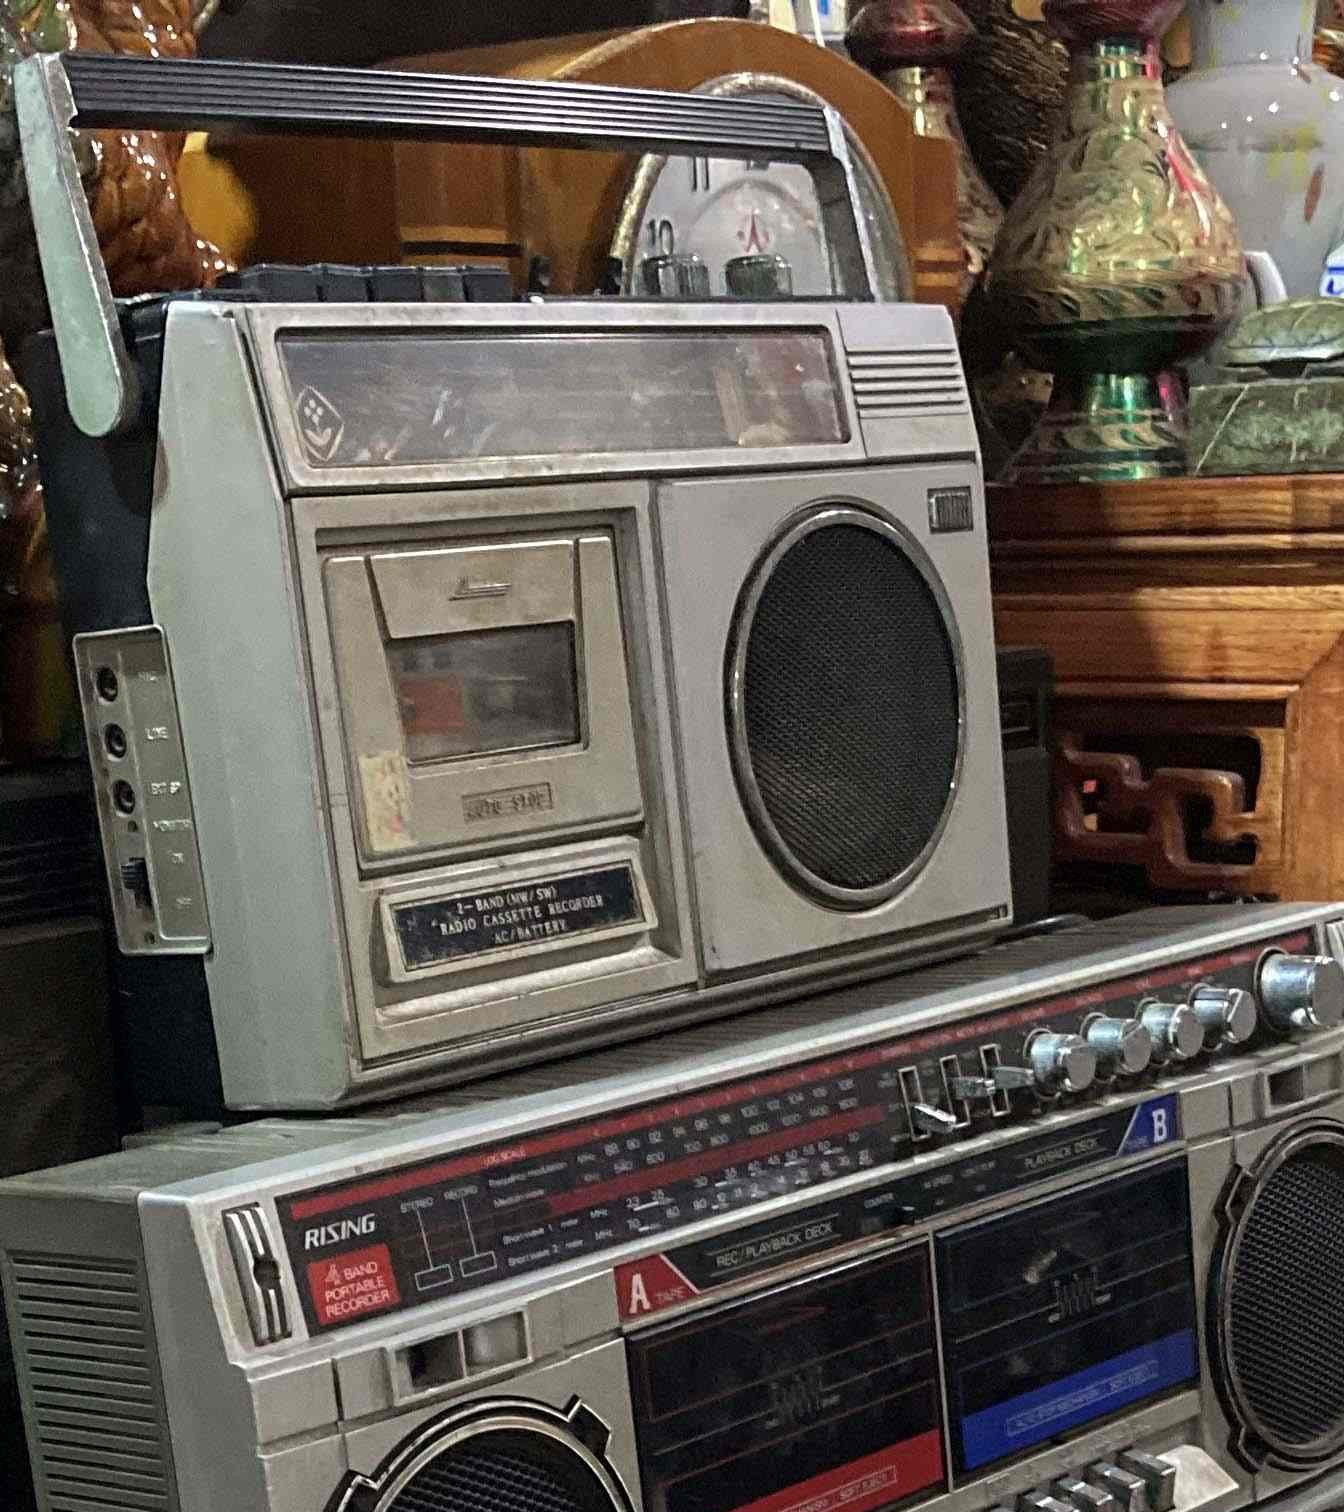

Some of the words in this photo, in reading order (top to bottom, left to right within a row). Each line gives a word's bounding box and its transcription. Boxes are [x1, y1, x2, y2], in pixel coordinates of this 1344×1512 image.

[440, 917, 477, 936] RADIO
[483, 907, 543, 928] CASSETTE
[548, 893, 605, 916] RECORDER
[494, 919, 567, 945] AC/BATTERY
[1152, 1108, 1168, 1144] B
[1024, 1146, 1071, 1169] PLAYBACK
[1074, 1137, 1099, 1154] DECK
[304, 1212, 376, 1251] RISING
[805, 1219, 834, 1240] DECK
[343, 1261, 378, 1281] BAND
[325, 1275, 386, 1303] PORTABLE
[325, 1289, 390, 1319] RECORDER
[628, 1272, 651, 1314] A
